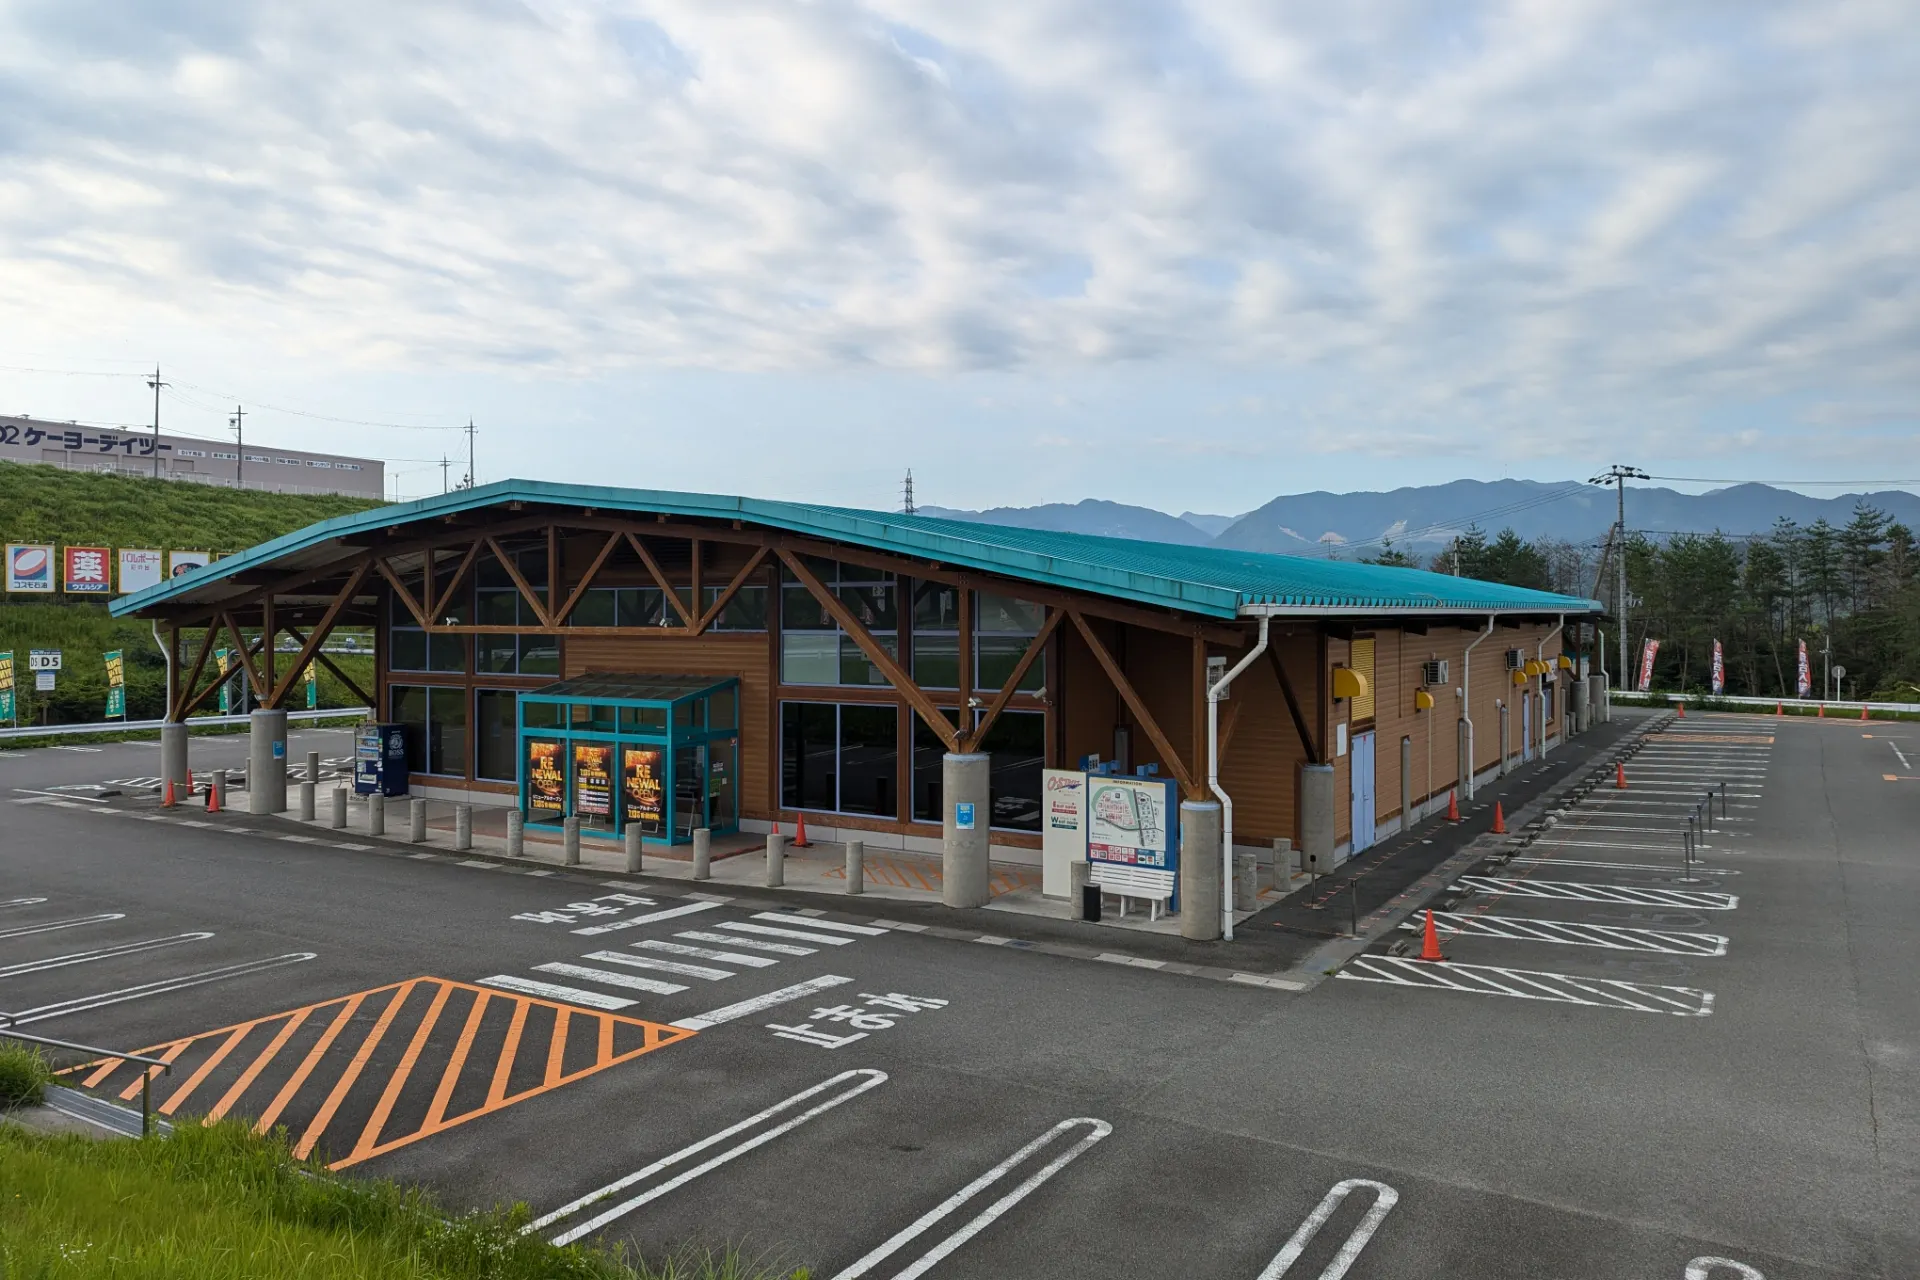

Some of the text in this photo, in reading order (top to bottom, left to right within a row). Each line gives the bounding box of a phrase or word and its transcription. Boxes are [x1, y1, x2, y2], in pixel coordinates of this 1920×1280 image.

[73, 551, 103, 581] 薬
[14, 581, 48, 589] コスモ石油
[540, 756, 554, 770] RE
[532, 768, 563, 781] NEWAL
[636, 764, 651, 778] RE
[626, 776, 661, 790] NEWAL
[632, 788, 654, 798] OPEN
[510, 893, 659, 924] 止まれ
[765, 993, 950, 1049] 止まれ
